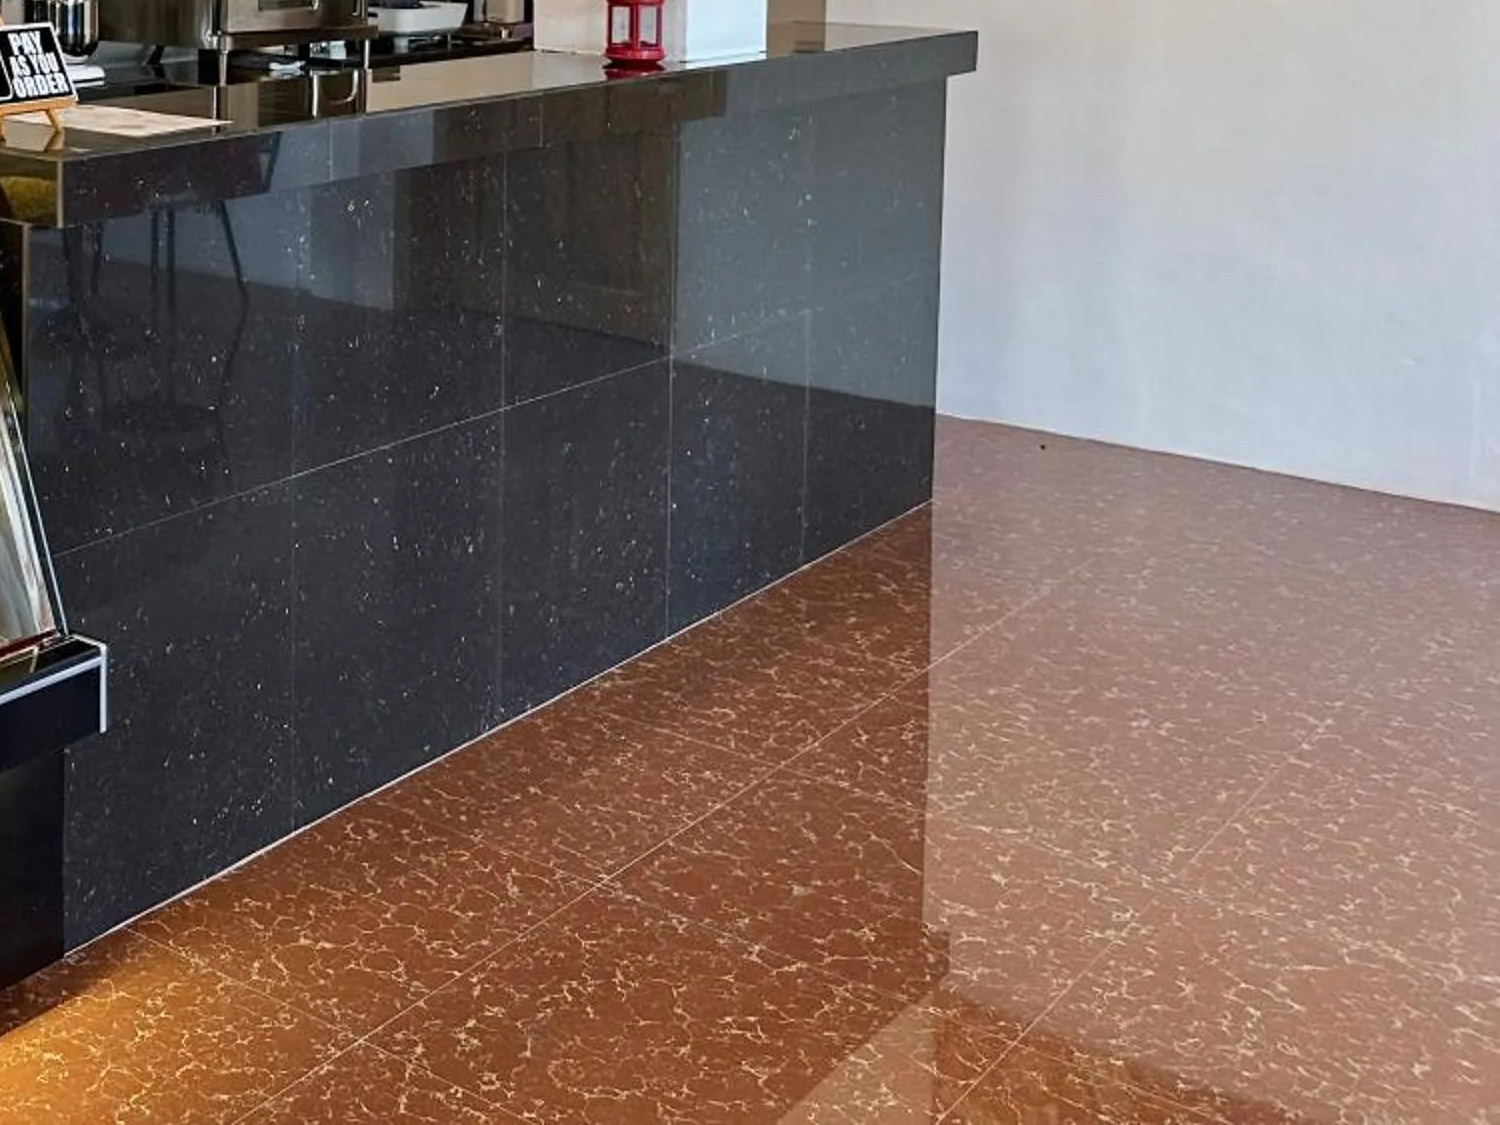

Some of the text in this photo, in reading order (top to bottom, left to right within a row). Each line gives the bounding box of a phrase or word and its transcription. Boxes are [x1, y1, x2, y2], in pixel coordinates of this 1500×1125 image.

[7, 30, 43, 56] PAY
[9, 51, 60, 77] AS YOU
[12, 71, 69, 98] ORDER
